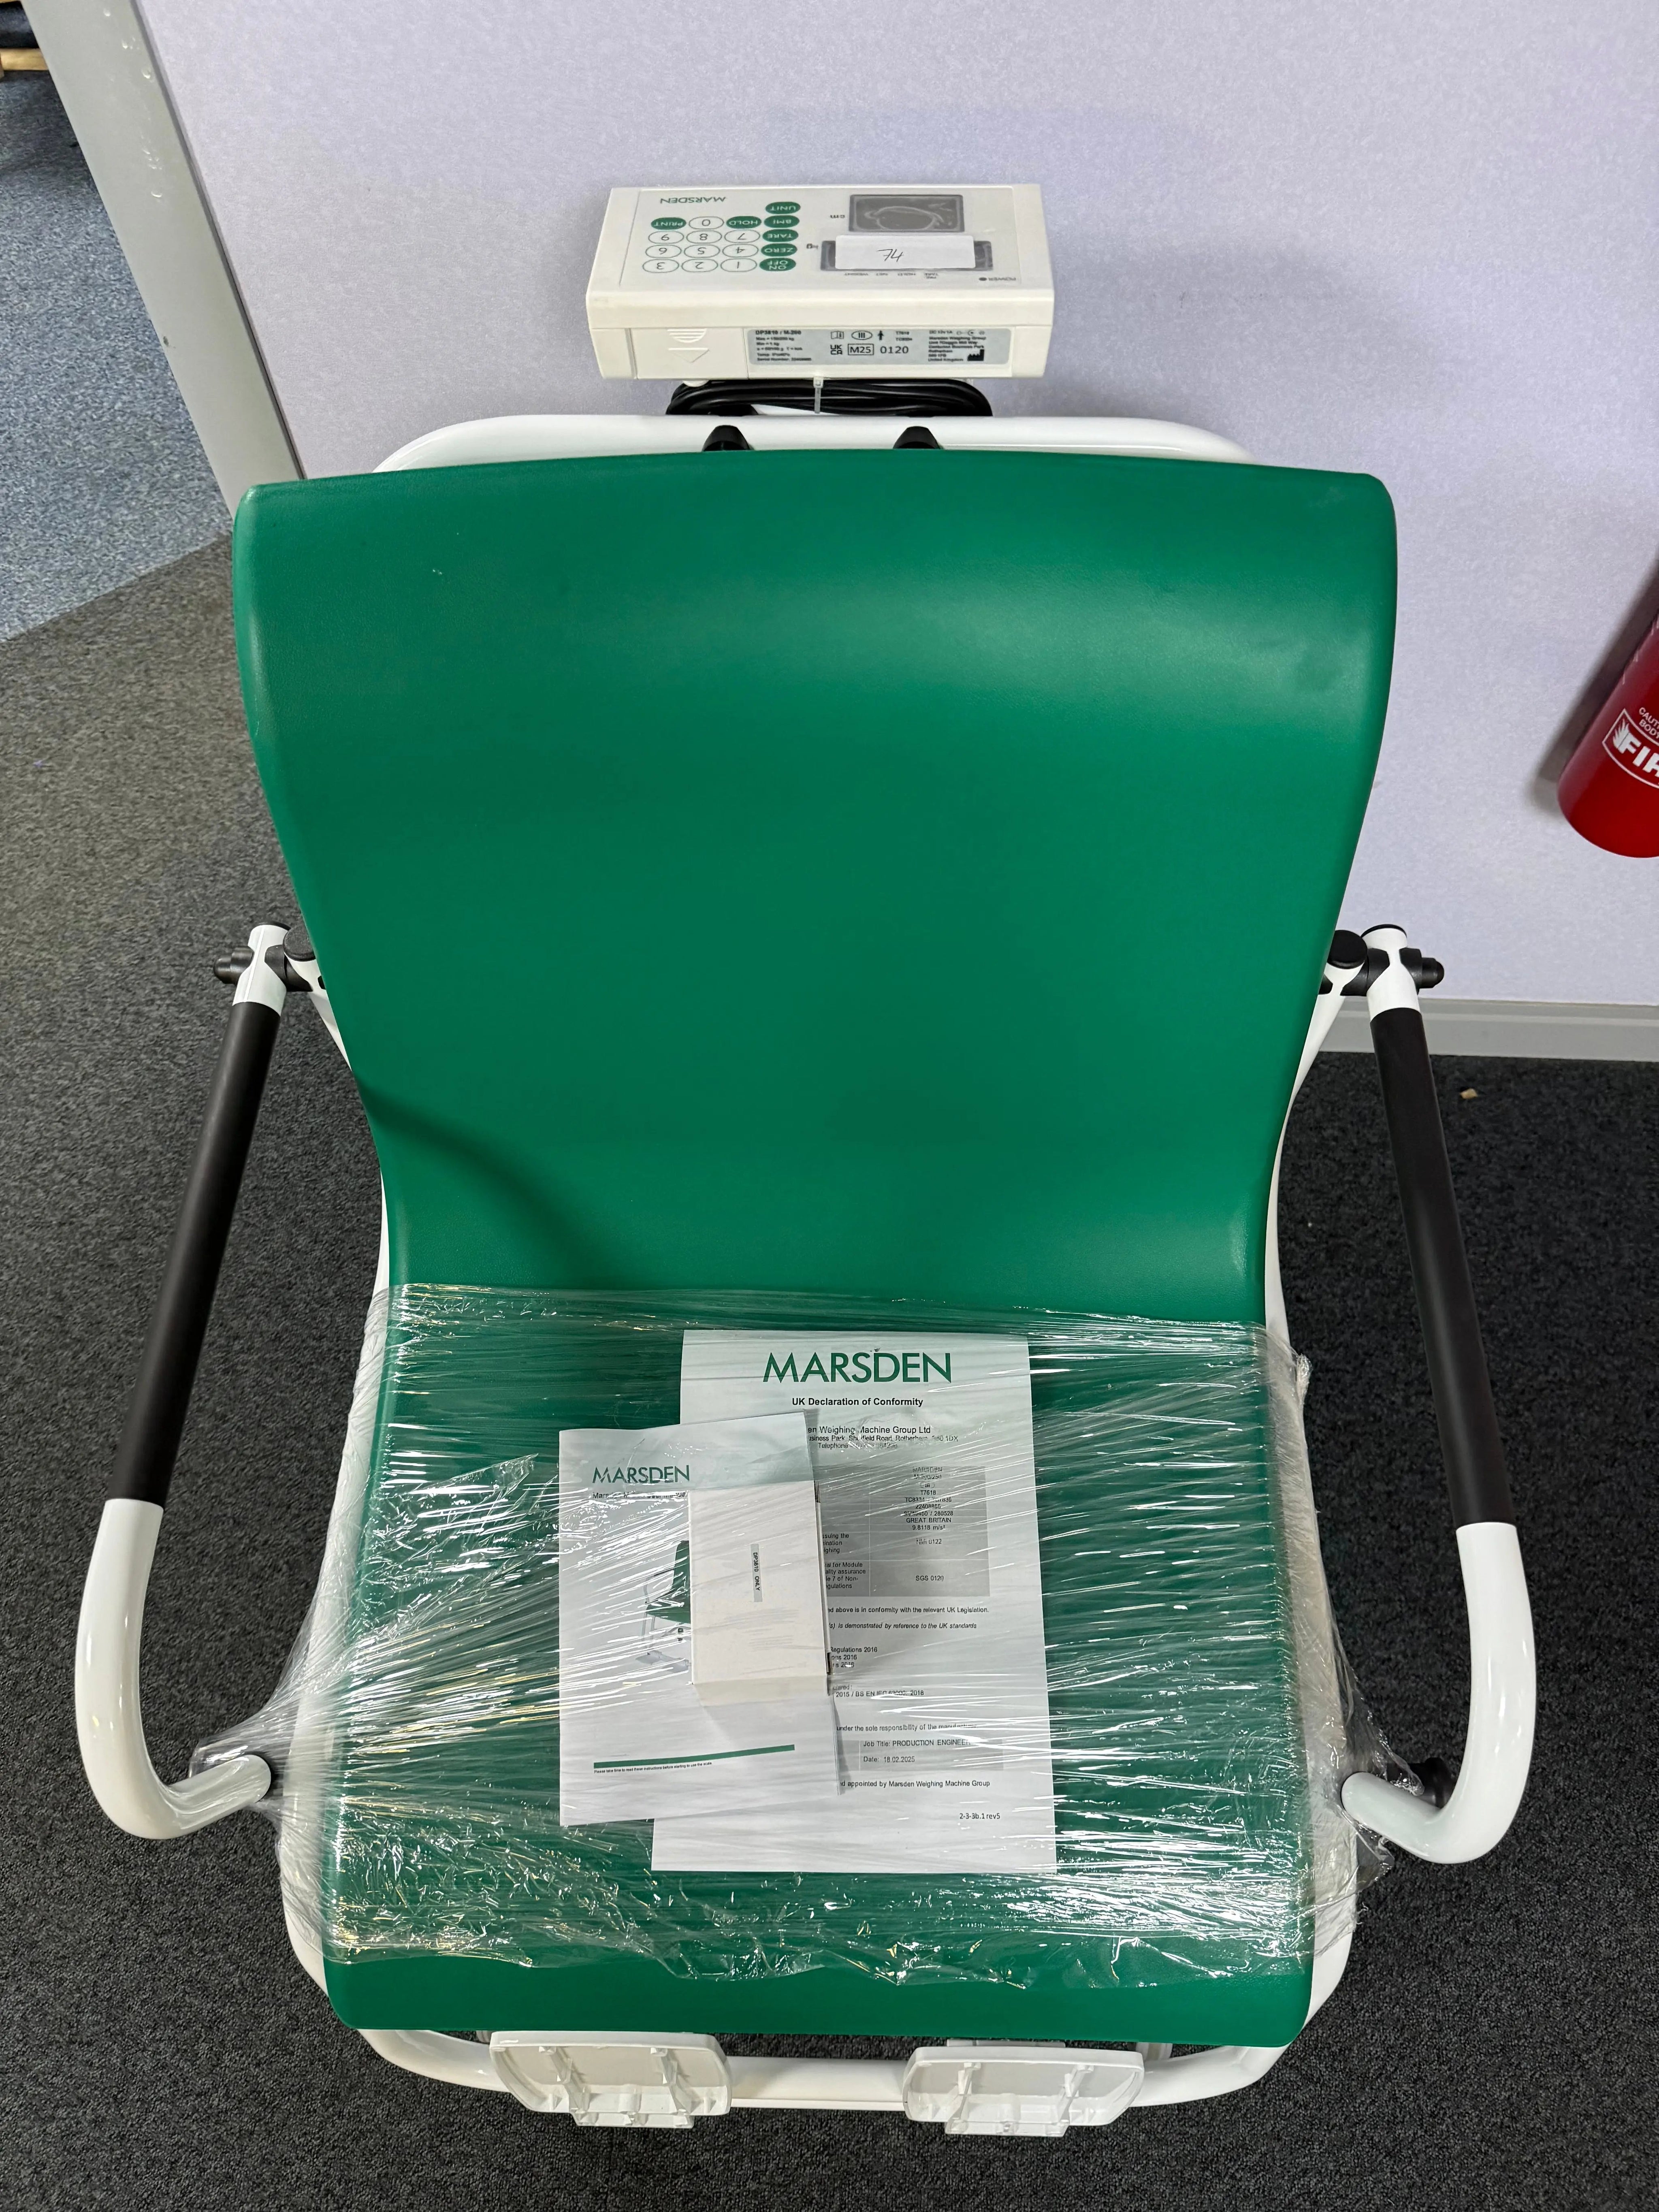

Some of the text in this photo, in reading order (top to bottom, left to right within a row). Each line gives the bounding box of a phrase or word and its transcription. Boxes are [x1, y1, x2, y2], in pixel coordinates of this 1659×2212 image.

[876, 248, 904, 262] 74
[880, 346, 909, 354] 0120
[763, 1352, 951, 1383] MARSDEN
[808, 1397, 859, 1406] Declaration
[861, 1397, 871, 1406] of
[874, 1397, 923, 1407] Conformity
[819, 1426, 855, 1434] Weighing
[893, 1426, 916, 1434] Group
[592, 1465, 690, 1484] MARSDEN
[879, 1724, 917, 1732] responsibility
